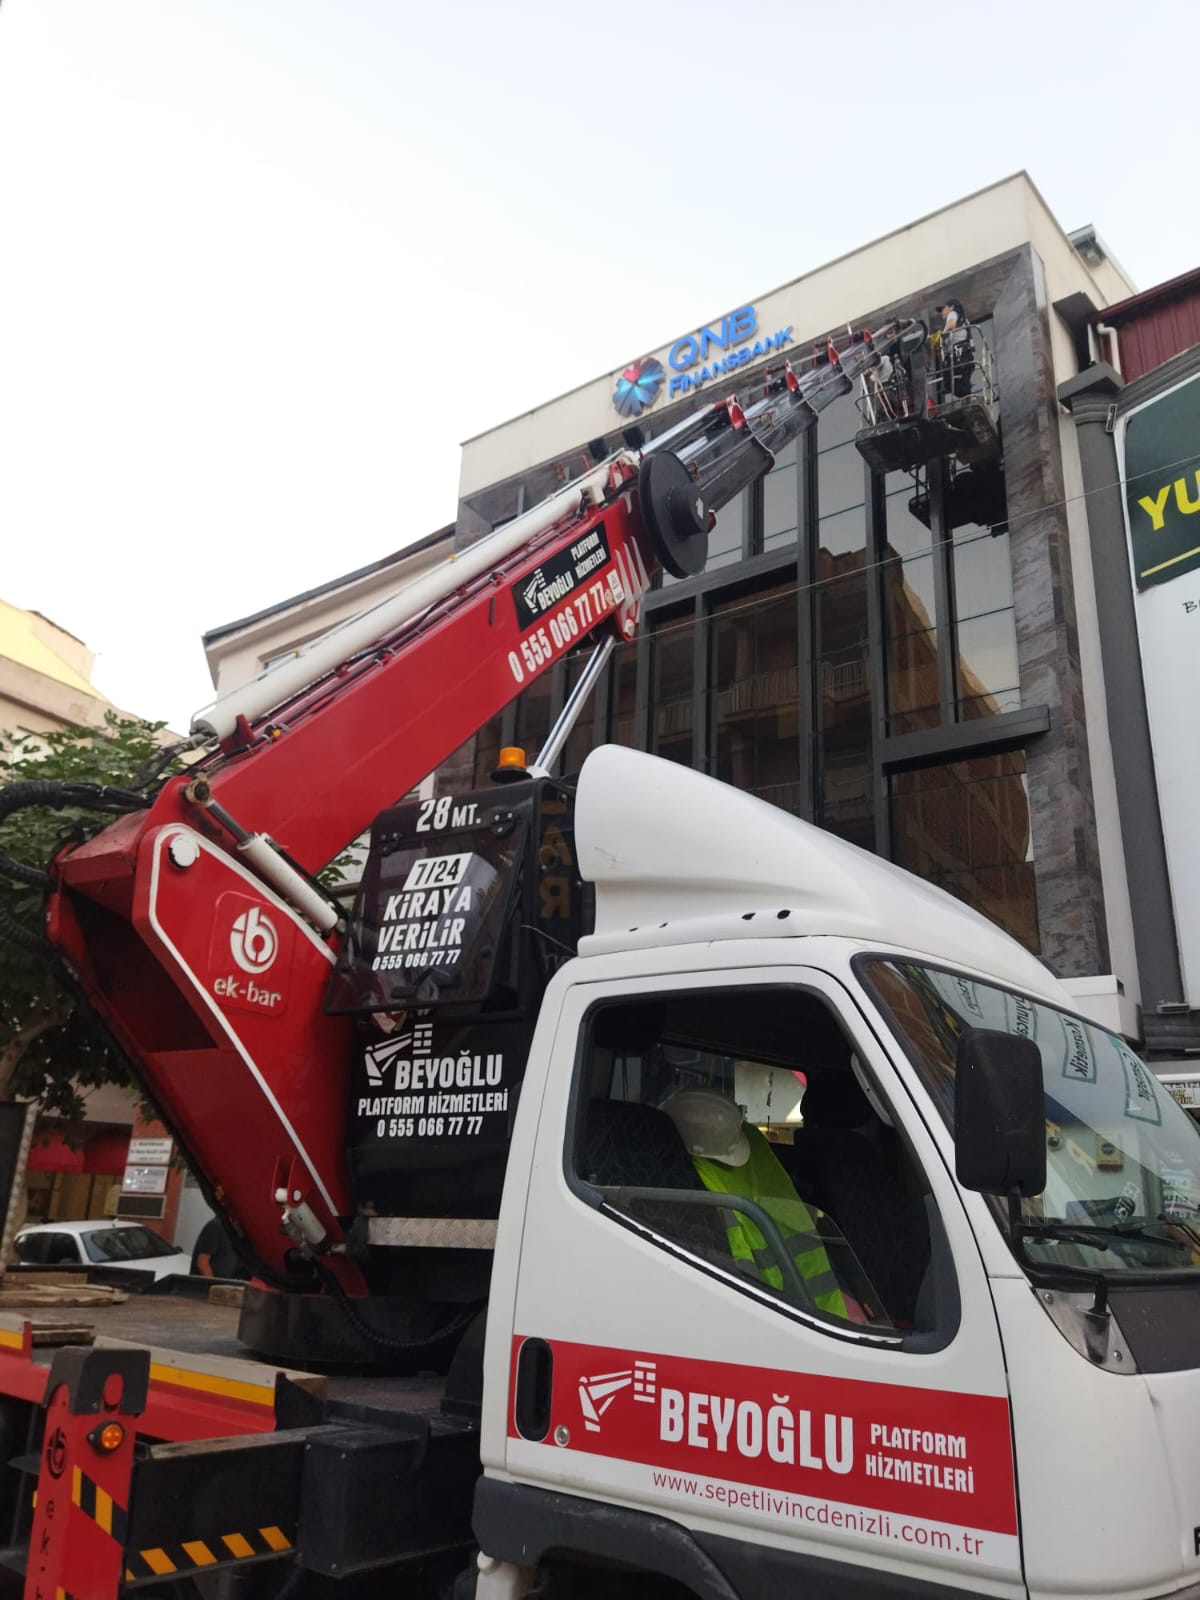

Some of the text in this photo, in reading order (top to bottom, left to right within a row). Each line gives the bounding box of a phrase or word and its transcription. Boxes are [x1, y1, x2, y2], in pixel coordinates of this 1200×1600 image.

[668, 304, 758, 371] QNB
[669, 325, 794, 398] FINANSBANK
[570, 531, 601, 561] PLATFORM
[537, 570, 575, 610] BEYOĞLU
[508, 651, 524, 683] 0
[520, 628, 553, 672] 555
[549, 606, 579, 649] 066
[574, 592, 593, 628] 77
[589, 581, 608, 616] 77
[416, 796, 481, 832] 28 MT.
[413, 858, 460, 887] 7/24
[380, 955, 402, 969] 555
[405, 952, 428, 968] 066
[428, 951, 447, 966] 77
[446, 949, 461, 965] 77
[213, 974, 282, 1008] ek-bar
[394, 1049, 503, 1090] BEYOĞLU
[357, 1088, 509, 1117] PLATFORM HİZMETLERİ
[376, 1115, 483, 1138] 0 555 066 77 77
[659, 1387, 854, 1475] BEYOĞLU
[869, 1422, 967, 1459] PLATFORM
[865, 1453, 975, 1494] HİZMETLERİ
[652, 1471, 984, 1556] www.sepetlivincdenizli.com.tr
